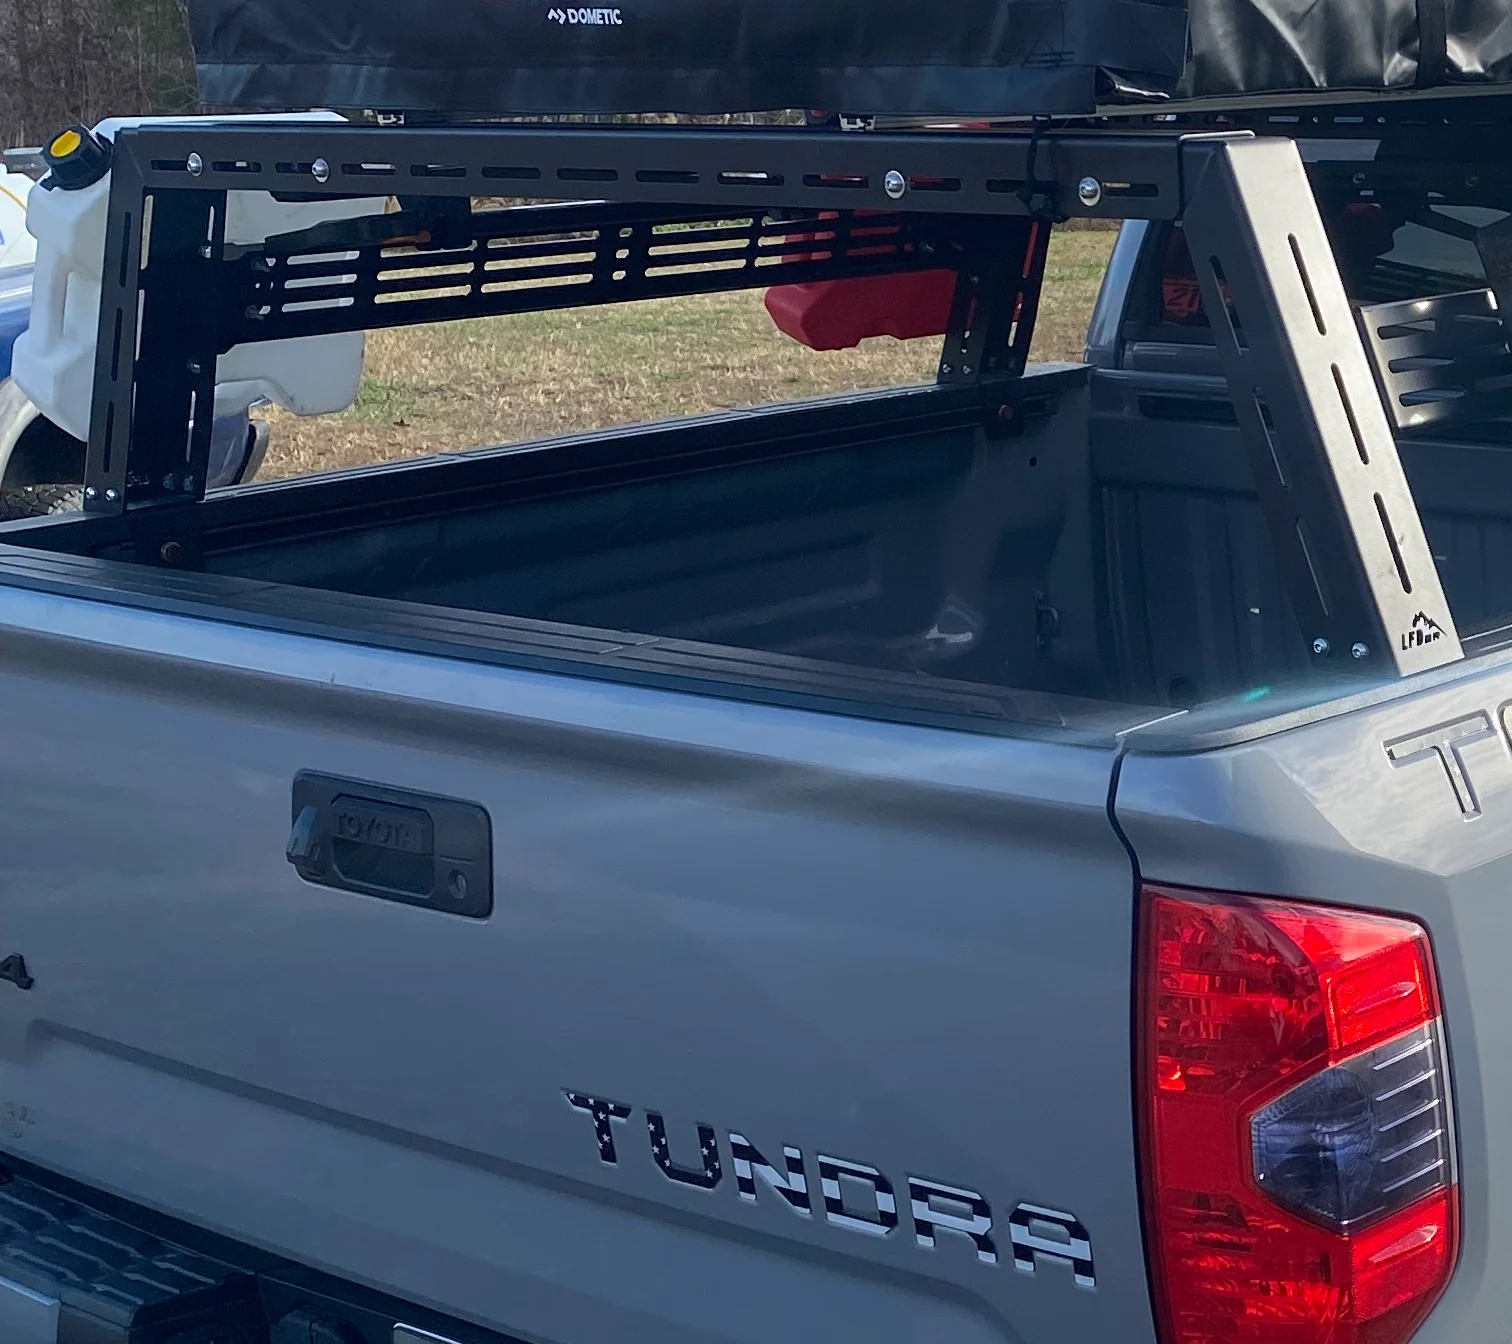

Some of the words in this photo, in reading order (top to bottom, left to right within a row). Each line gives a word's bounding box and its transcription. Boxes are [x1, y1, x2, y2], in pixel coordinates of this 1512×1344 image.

[567, 8, 623, 25] DOMETIC
[335, 813, 414, 849] TOYOTA
[562, 1089, 1097, 1288] TUNDRA
